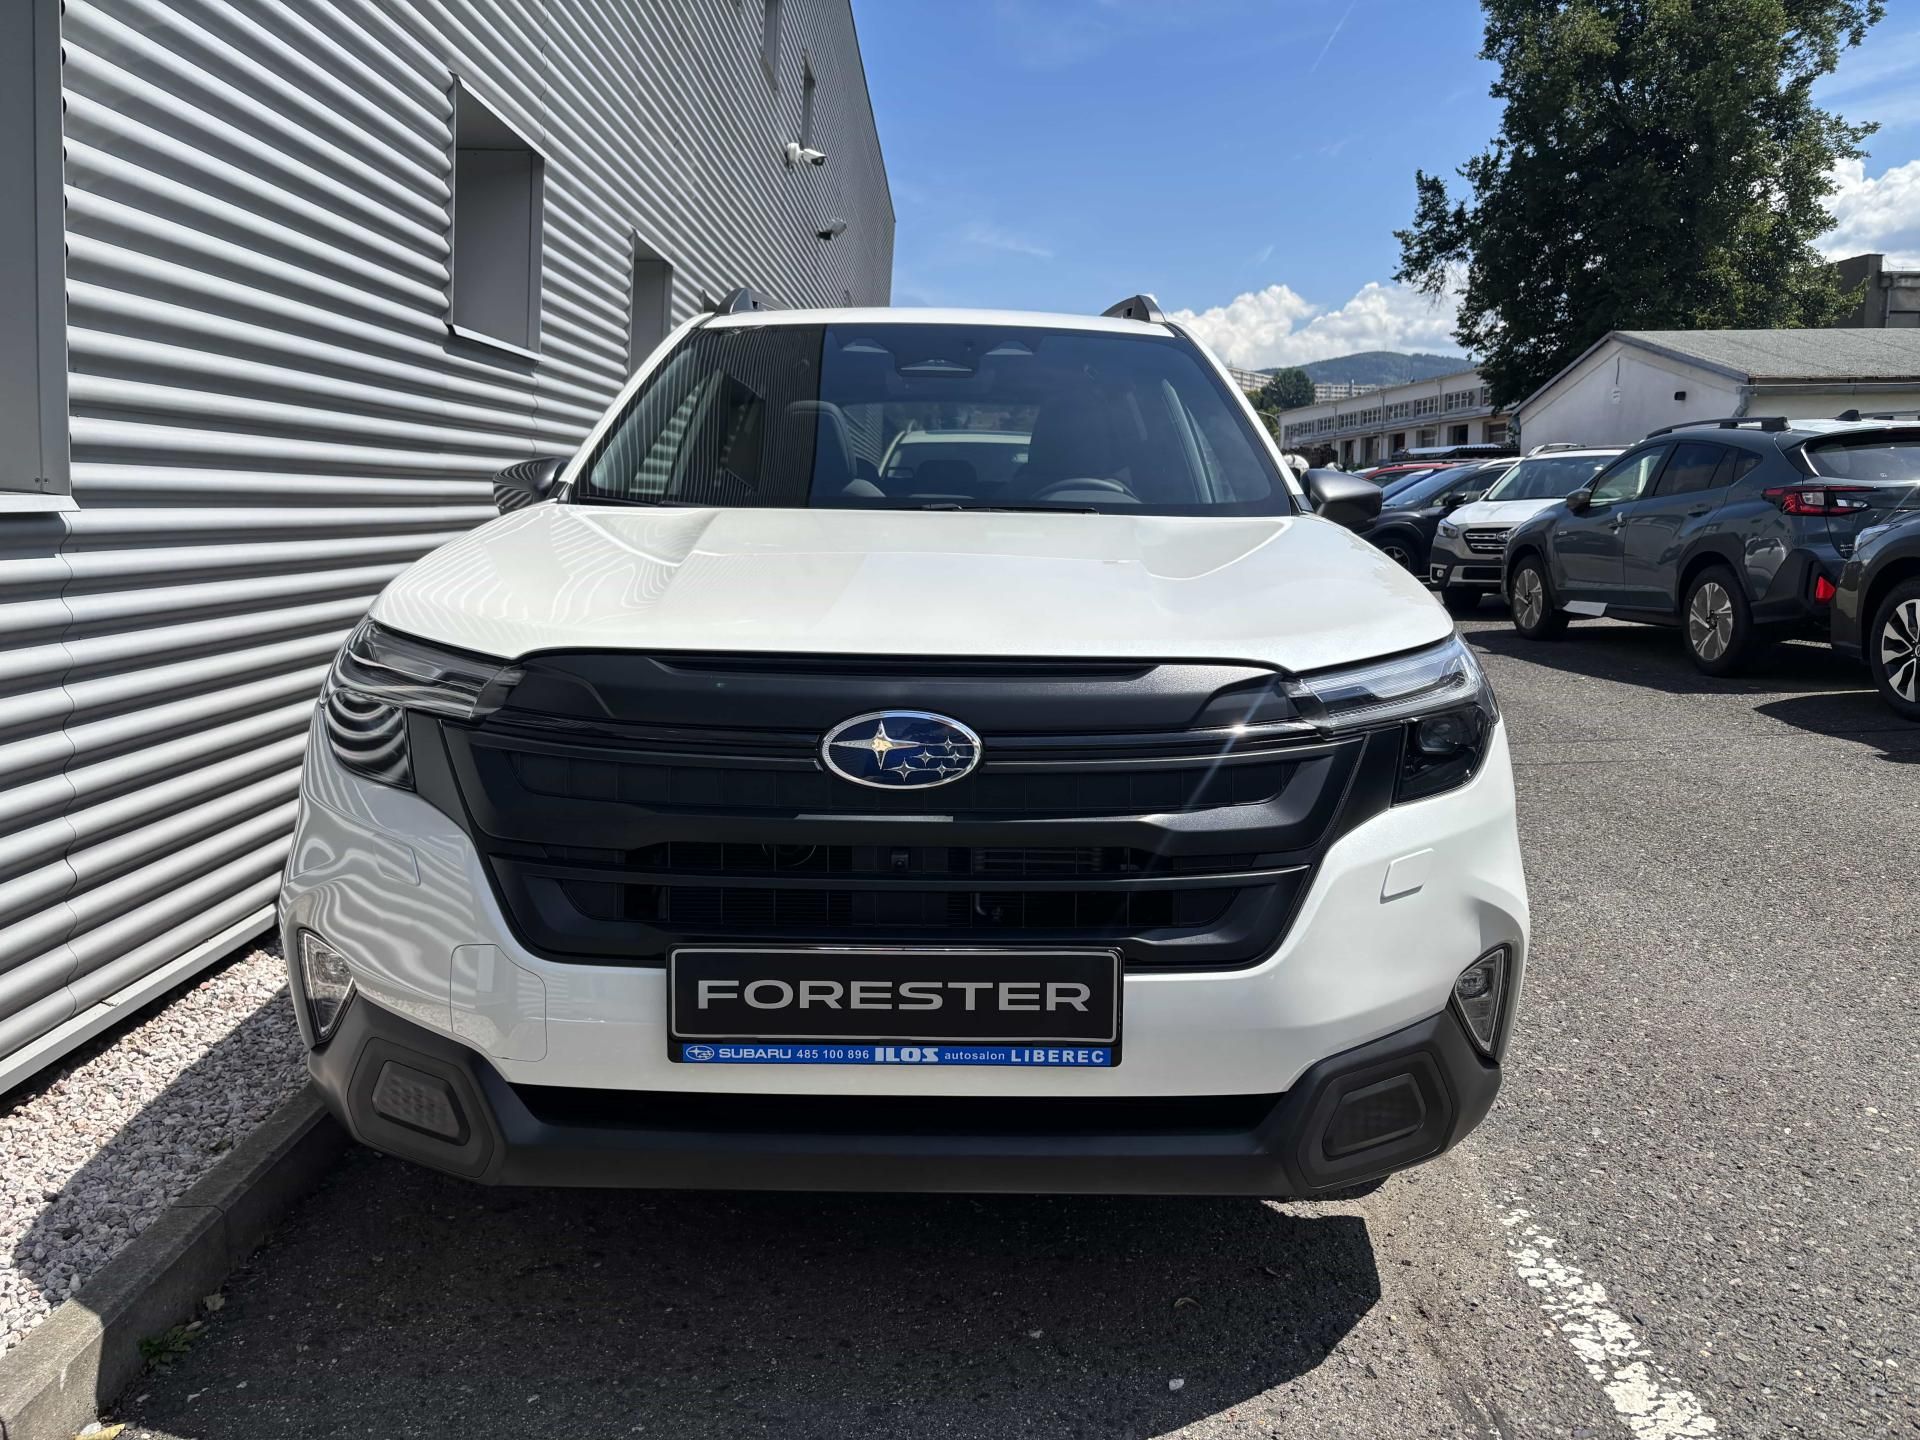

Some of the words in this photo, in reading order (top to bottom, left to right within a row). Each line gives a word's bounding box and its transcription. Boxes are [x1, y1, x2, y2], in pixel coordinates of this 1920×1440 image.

[698, 980, 1091, 1012] FORESTER
[719, 1048, 792, 1060] SUBARU
[796, 1049, 819, 1059] 485
[823, 1049, 844, 1059] 100
[847, 1049, 870, 1060] 896
[874, 1047, 939, 1062] ILOS
[944, 1050, 1005, 1060] autosalon
[1011, 1049, 1104, 1063] LIBEREC
